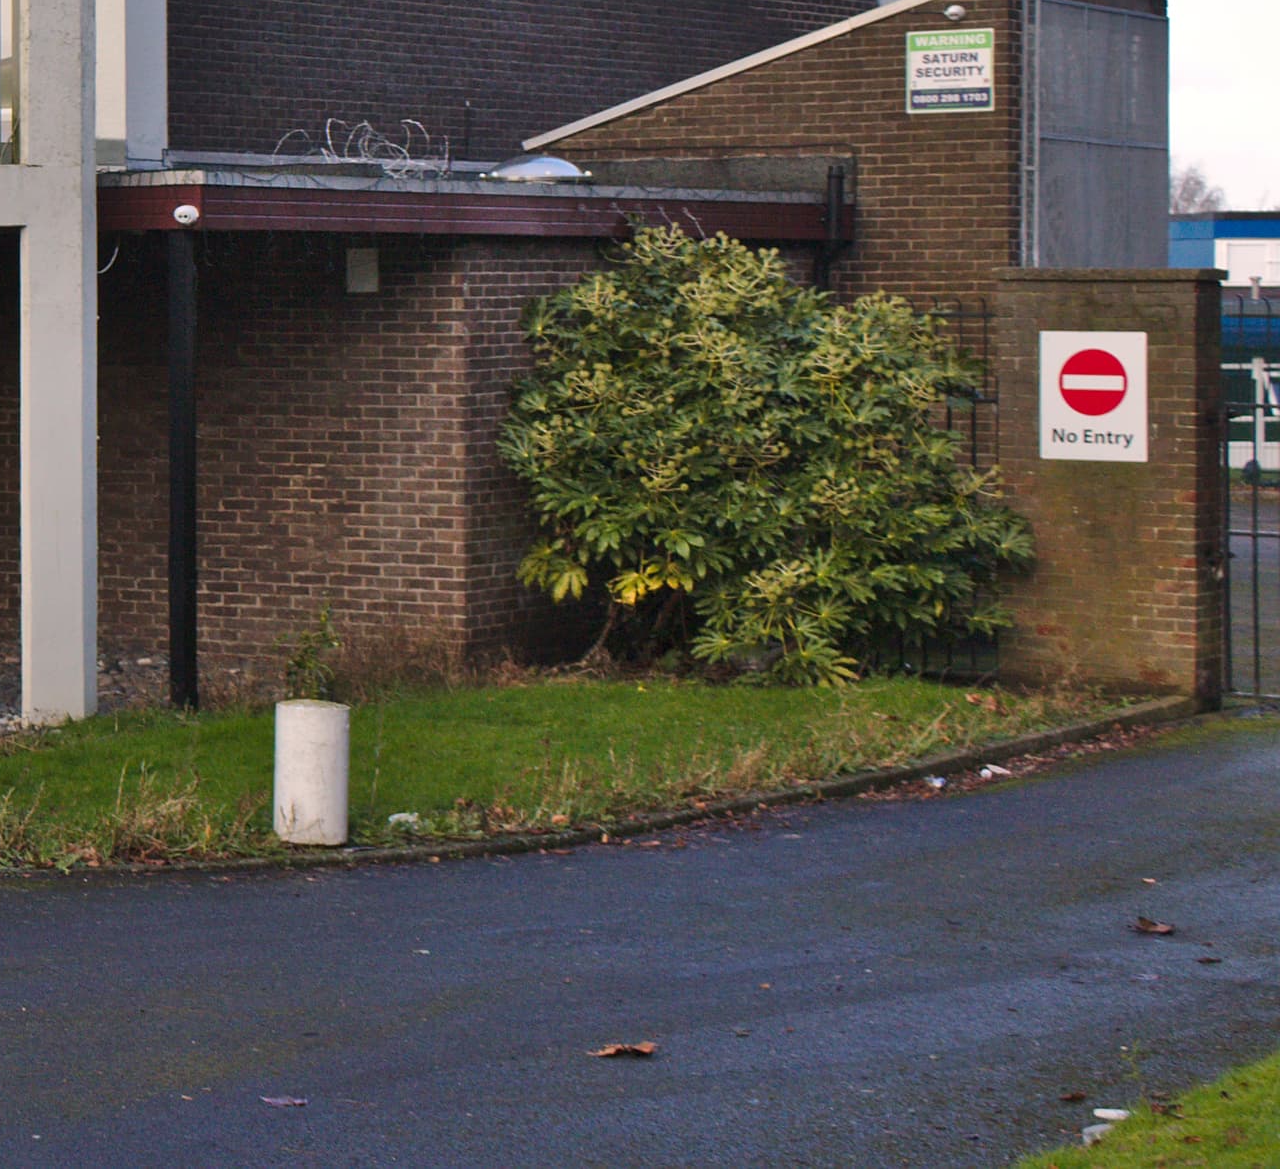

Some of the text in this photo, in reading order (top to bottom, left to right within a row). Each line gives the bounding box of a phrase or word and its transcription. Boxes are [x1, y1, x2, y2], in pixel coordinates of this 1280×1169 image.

[915, 34, 985, 46] WARNING
[922, 52, 978, 64] SATURN
[916, 66, 984, 78] SECURITY
[913, 95, 938, 103] 0800
[1052, 428, 1134, 448] No Entry
